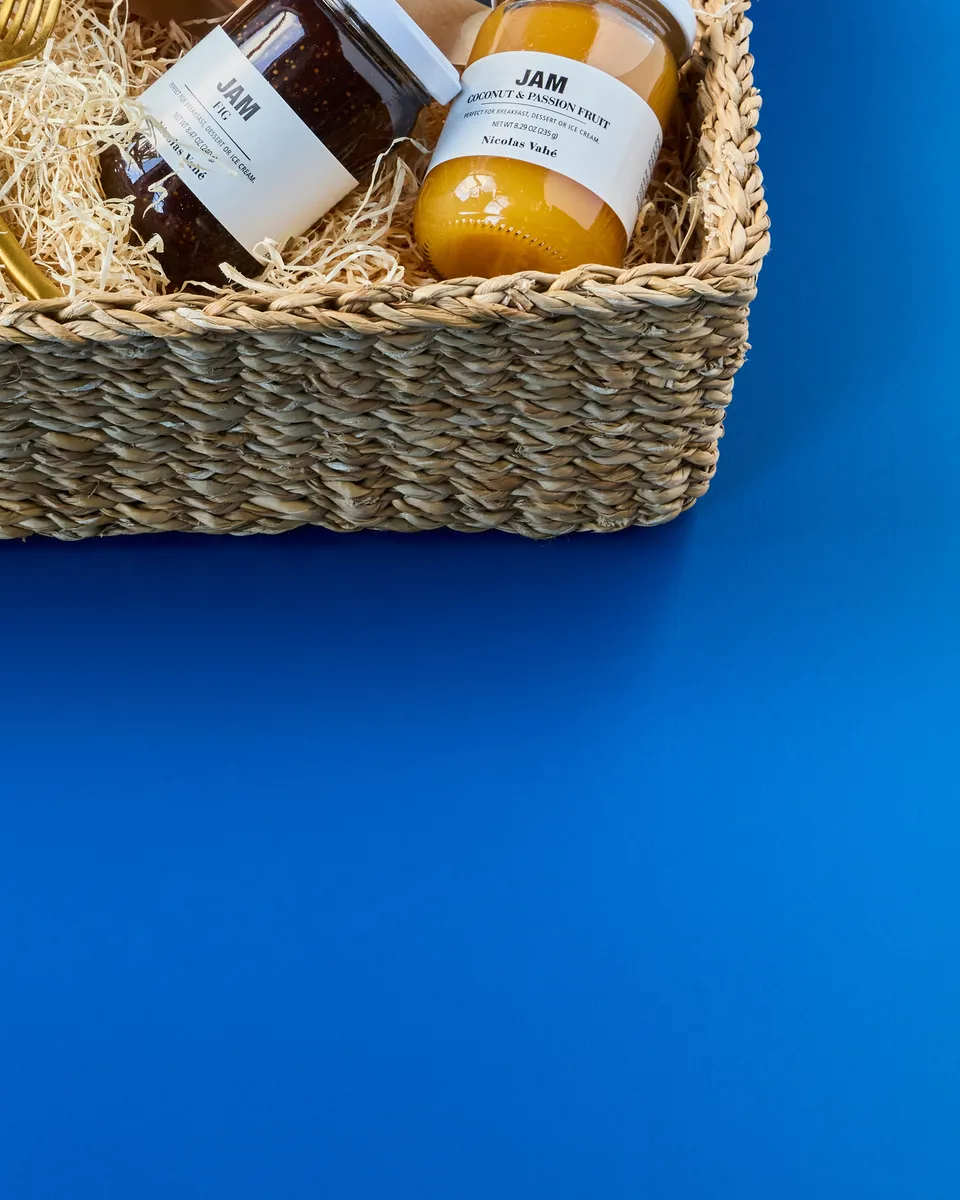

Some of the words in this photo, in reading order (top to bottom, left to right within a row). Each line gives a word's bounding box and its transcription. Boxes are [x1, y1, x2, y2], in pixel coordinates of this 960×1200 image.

[515, 68, 569, 94] JAM
[212, 101, 232, 120] FIG
[216, 78, 262, 122] JAM
[467, 90, 515, 104] COCONUT
[516, 91, 524, 99] &
[527, 92, 576, 112] PASSION
[578, 107, 610, 130] FRUIT
[169, 82, 182, 96] PERFECT
[205, 126, 226, 148] DESSERT
[223, 146, 232, 156] OR
[230, 154, 240, 164] ICE
[238, 163, 256, 184] CREAM.
[173, 112, 182, 124] NET
[180, 120, 189, 129] WT
[186, 127, 197, 139] 8.47
[194, 136, 204, 147] OZ
[463, 110, 484, 119] PERFECT
[496, 109, 529, 118] BREAKFAST,
[531, 112, 557, 124] DESSERT
[568, 124, 578, 132] ICE
[580, 129, 600, 144] CREAM.
[537, 127, 551, 137] (235
[481, 135, 525, 148] Nicolas
[530, 141, 558, 158] Vahé
